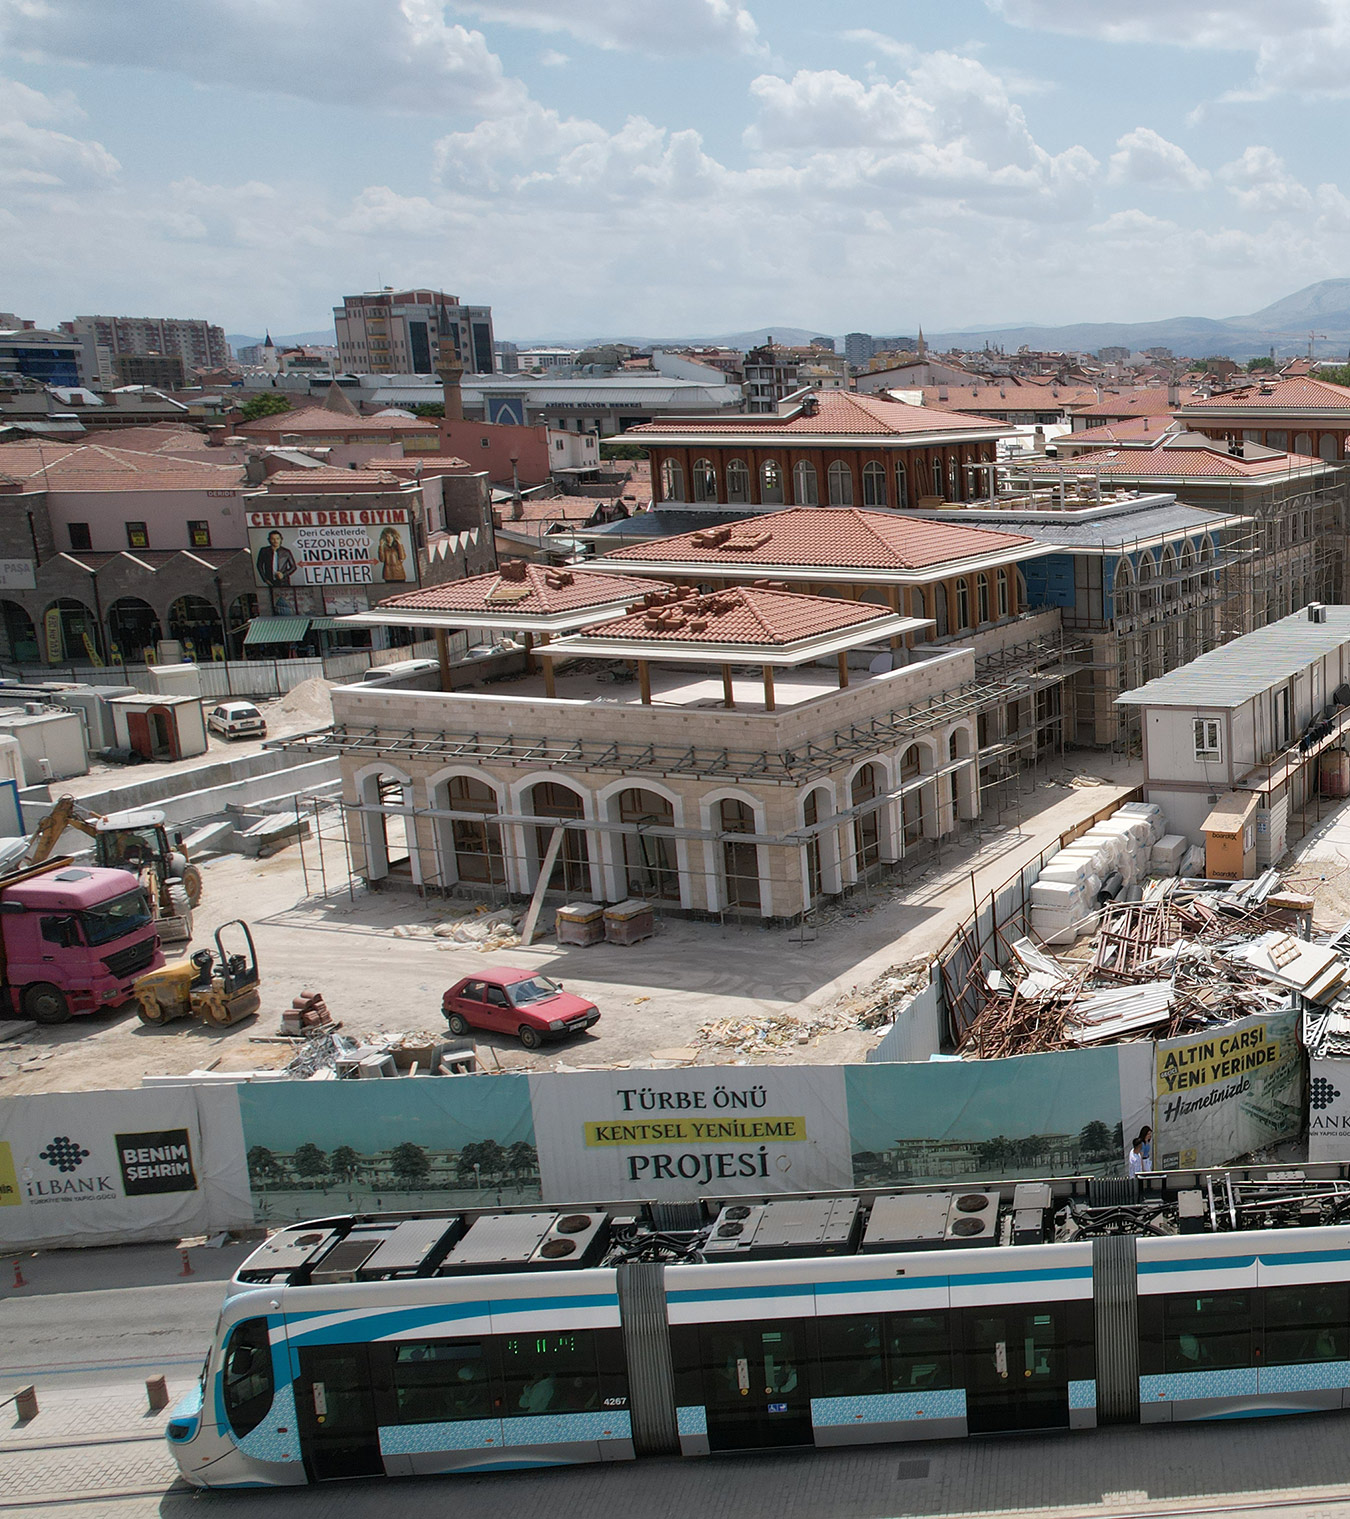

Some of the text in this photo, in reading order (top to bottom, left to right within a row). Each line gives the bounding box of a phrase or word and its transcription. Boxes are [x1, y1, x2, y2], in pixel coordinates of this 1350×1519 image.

[251, 511, 313, 526] CEYLAN
[299, 528, 366, 537] Deri Ceketlerde
[297, 538, 370, 549] SEZON BOYU
[304, 565, 372, 583] LEATHER
[1164, 1027, 1263, 1069] ALTIN ÇARŞI
[616, 1085, 767, 1112] TÜRBE ÖNÜ
[1164, 1075, 1251, 1122] Hizmetinizde
[595, 1119, 797, 1141] KENTSEL YENİLEME
[626, 1145, 771, 1186] PROJESİ
[603, 1397, 627, 1406] 4267
